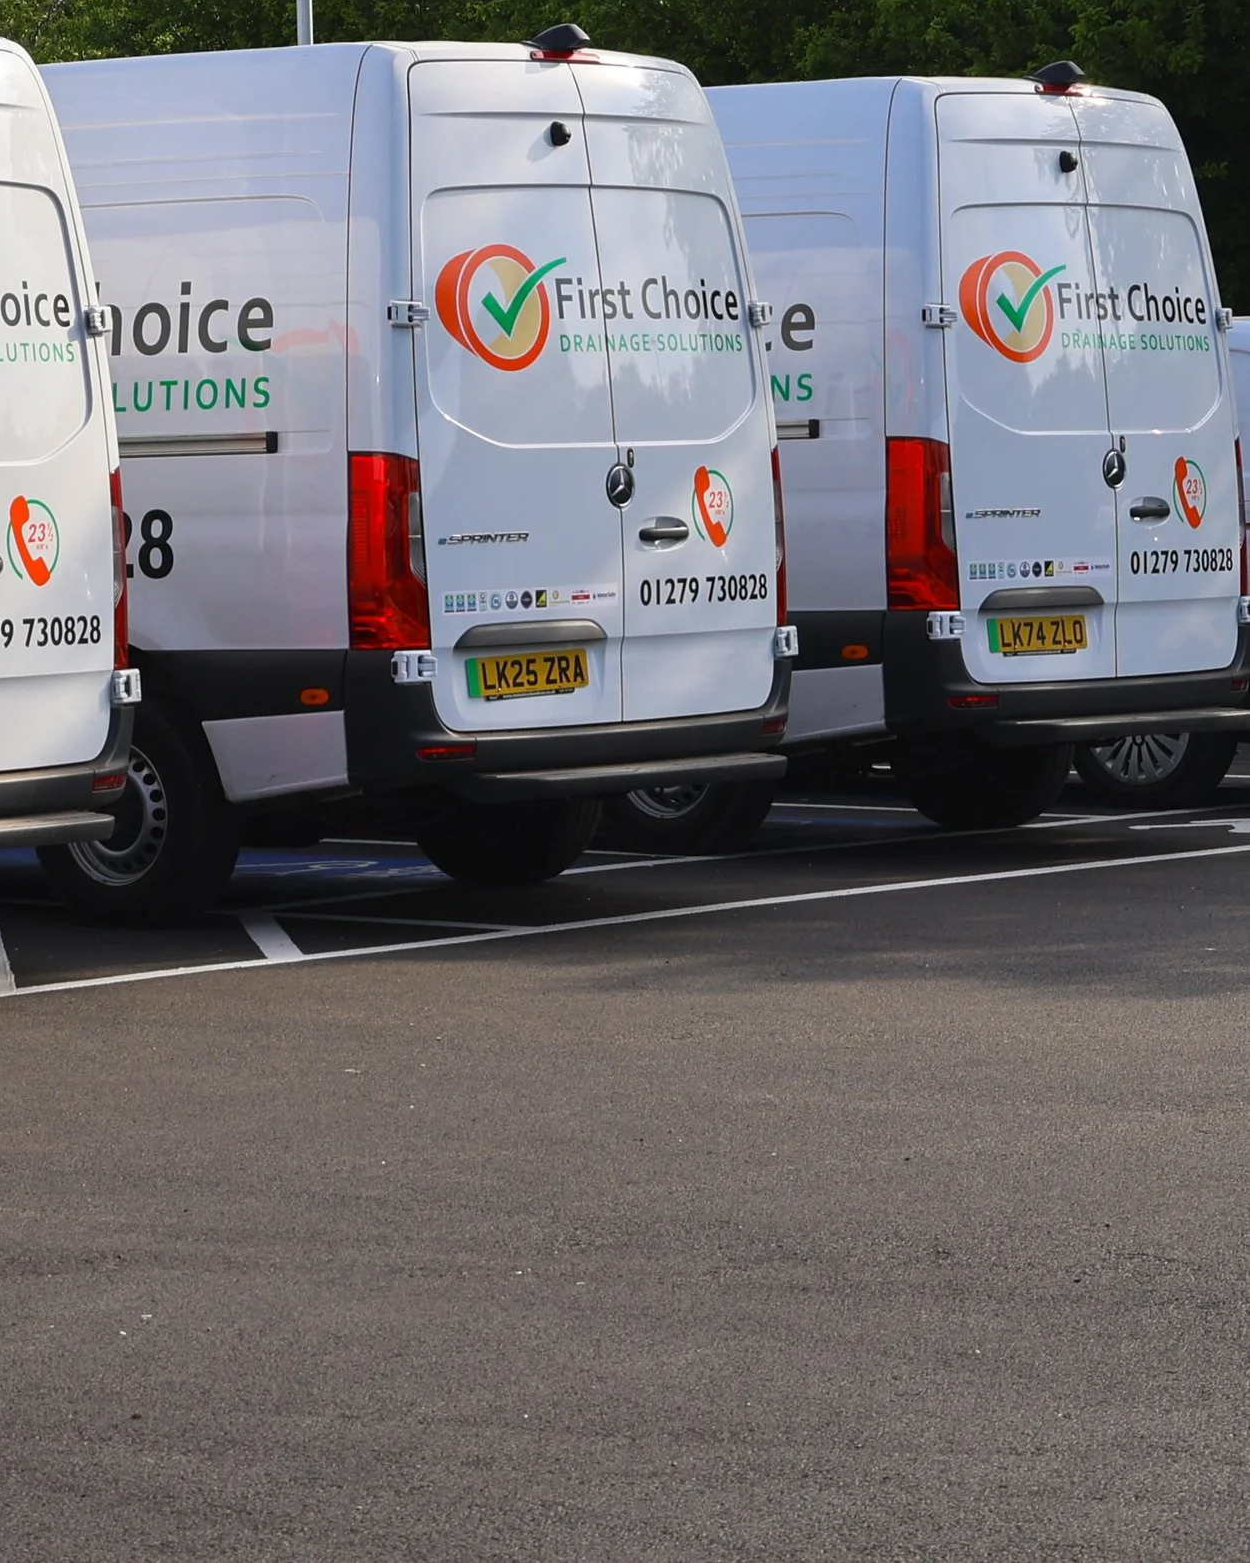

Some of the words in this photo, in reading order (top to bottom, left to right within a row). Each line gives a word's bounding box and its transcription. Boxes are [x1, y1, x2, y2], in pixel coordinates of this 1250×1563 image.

[555, 277, 633, 321] First
[641, 276, 739, 321] Choice
[1058, 283, 1121, 322] First
[1127, 283, 1207, 325] Choice
[560, 334, 650, 352] DRAINAGE
[657, 333, 743, 352] SOLUTIONS
[1062, 333, 1135, 349] DRAINAGE
[1141, 334, 1210, 352] SOLUTIONS
[1130, 551, 1178, 576] 01279
[1183, 548, 1233, 574] 730828
[640, 577, 698, 606] 01279
[706, 573, 767, 602] 730828
[23, 615, 102, 648] 730828
[1000, 620, 1046, 647] LK74
[1051, 619, 1083, 645] ZLO
[481, 659, 538, 690] LK25
[543, 654, 585, 684] ZRA
